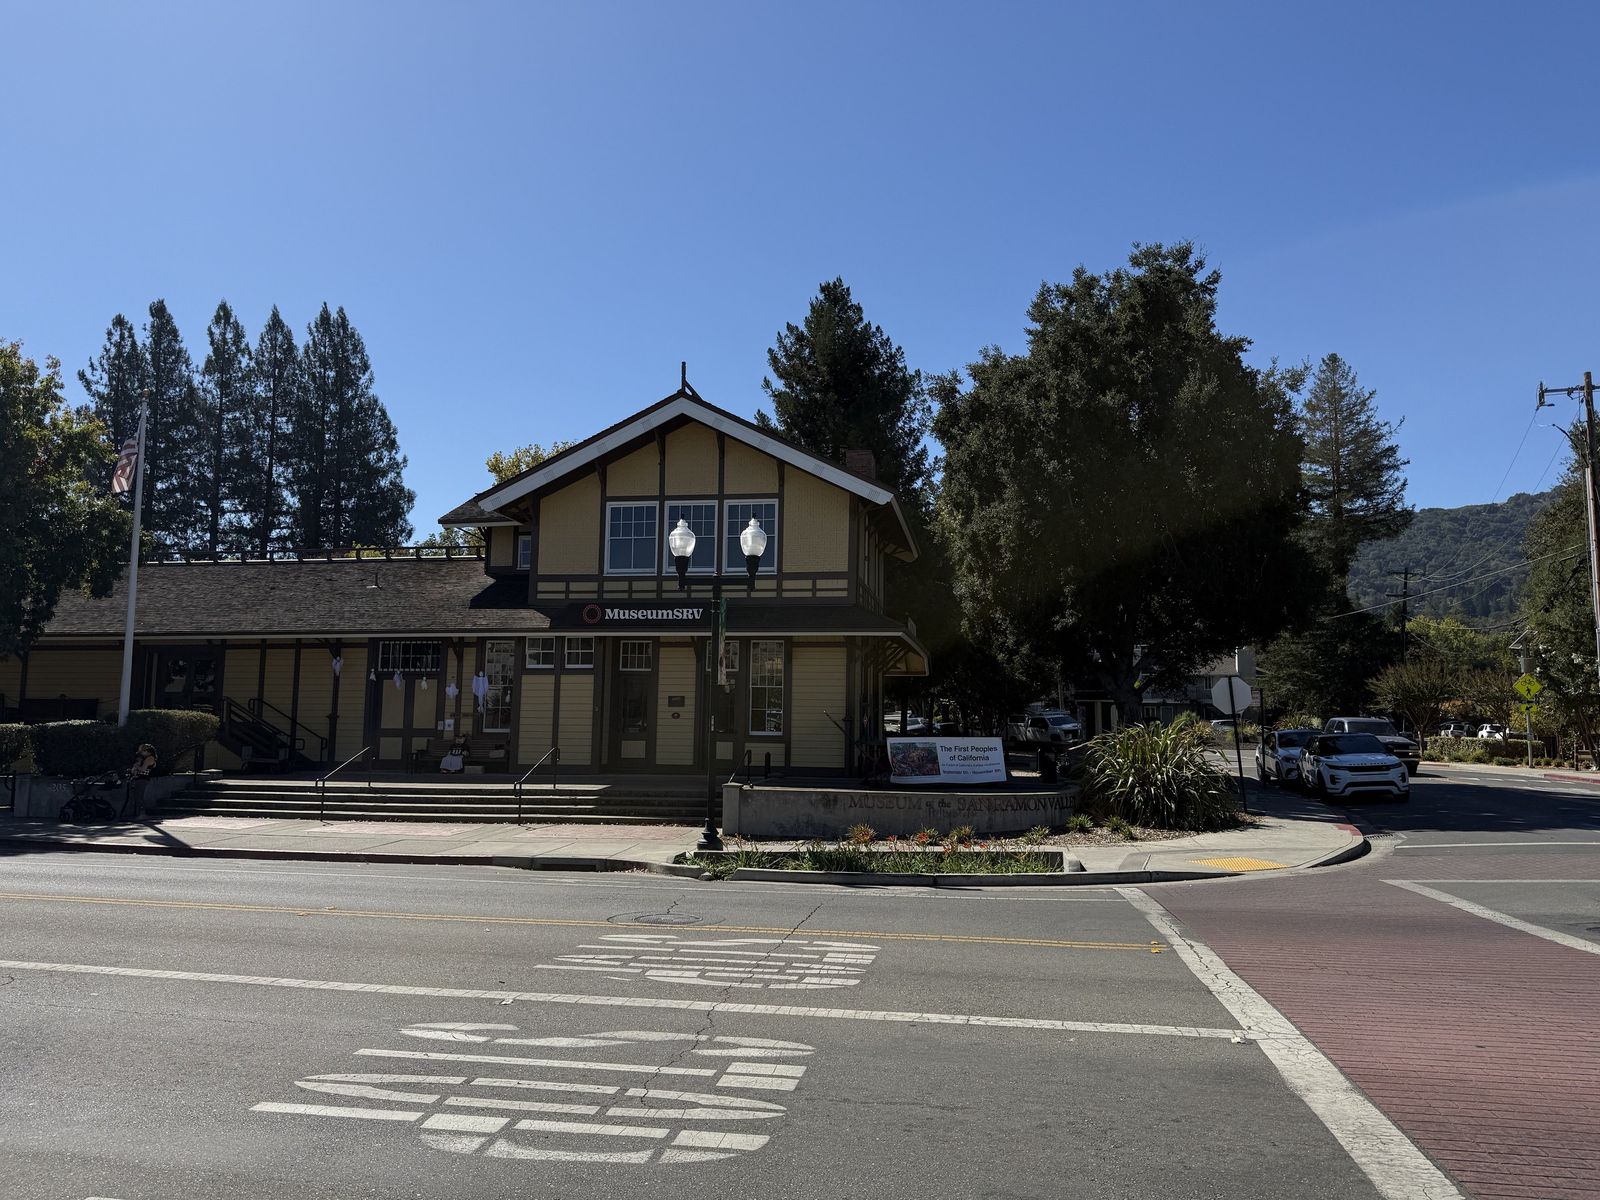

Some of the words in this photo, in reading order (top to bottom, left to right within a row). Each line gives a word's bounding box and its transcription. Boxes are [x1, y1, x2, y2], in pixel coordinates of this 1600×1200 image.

[604, 608, 704, 620] MuseumSRV
[970, 745, 998, 754] Peoples
[957, 754, 990, 762] California
[848, 795, 923, 809] MUSEUM
[957, 797, 990, 811] SAN
[991, 797, 1046, 811] RAMON
[532, 934, 882, 990] STOP
[247, 1021, 817, 1166] STOP
